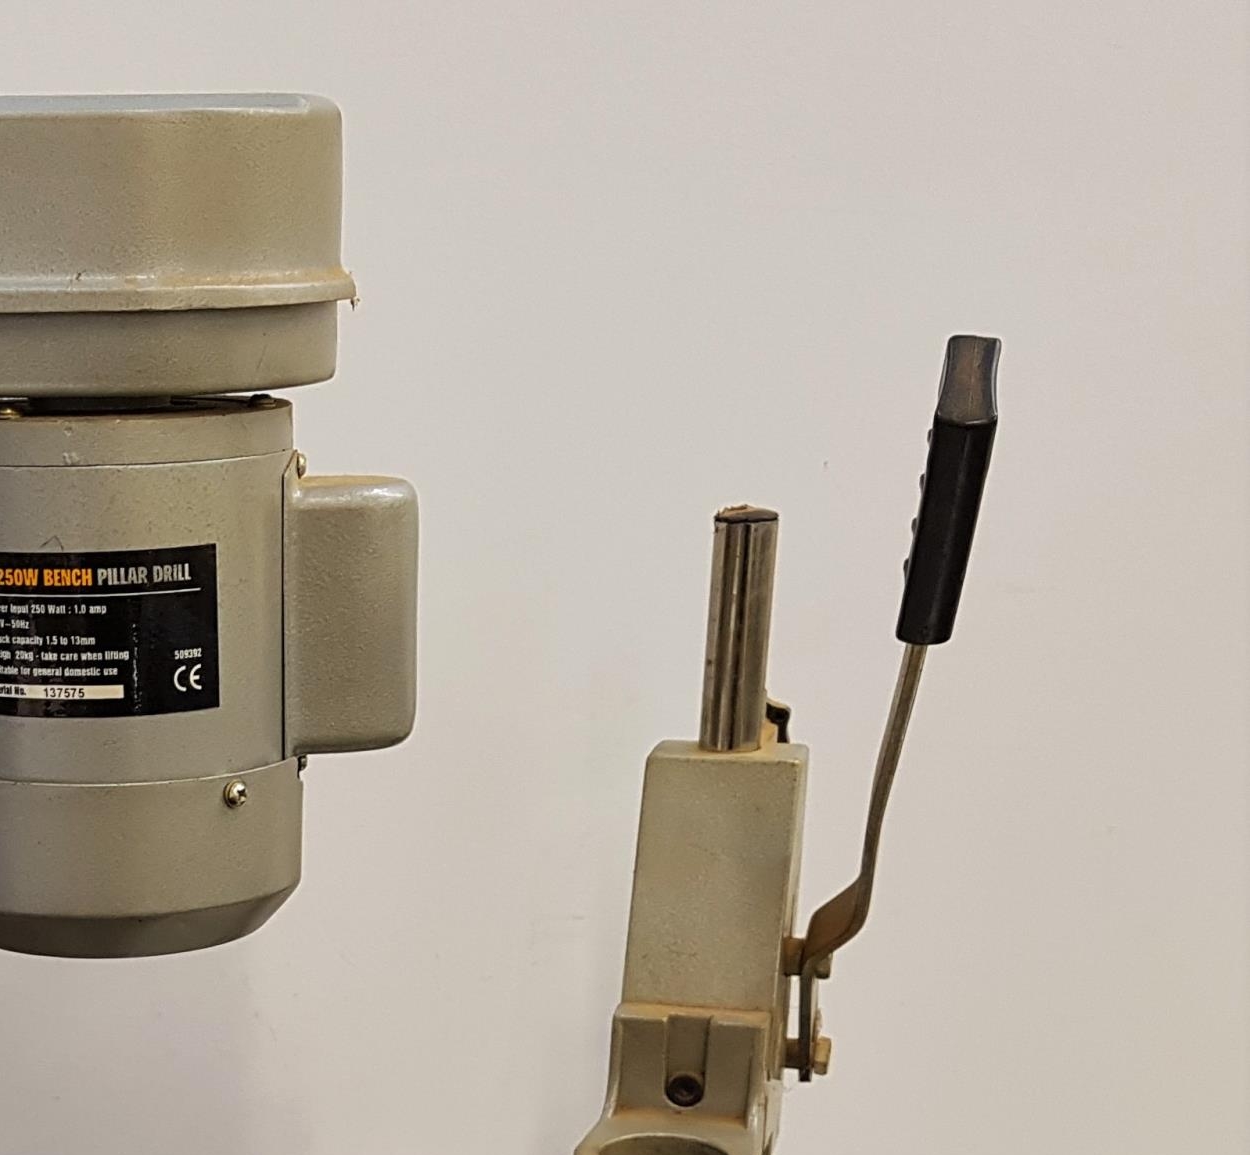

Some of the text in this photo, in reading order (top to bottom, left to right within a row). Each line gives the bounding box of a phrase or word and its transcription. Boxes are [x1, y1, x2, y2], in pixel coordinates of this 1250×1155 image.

[43, 568, 93, 587] BENCH
[97, 567, 148, 586] PILLAR
[153, 563, 192, 582] DRILL
[10, 603, 29, 614] Input
[31, 604, 46, 614] 250
[47, 604, 66, 614] Watt
[74, 604, 86, 614] 1.0
[89, 605, 107, 615] amp
[12, 635, 43, 646] capacity
[46, 635, 58, 645] 1.5
[59, 636, 68, 646] to
[70, 635, 96, 646] 13mm
[15, 650, 34, 661] 20kg
[41, 651, 58, 661] take
[60, 652, 79, 661] care
[80, 651, 103, 661] when
[104, 650, 130, 661] lifting
[20, 666, 31, 675] for
[32, 666, 62, 677] general
[64, 666, 101, 677] domestic
[103, 667, 118, 676] use
[14, 686, 27, 696] No.
[43, 687, 85, 698] 137575
